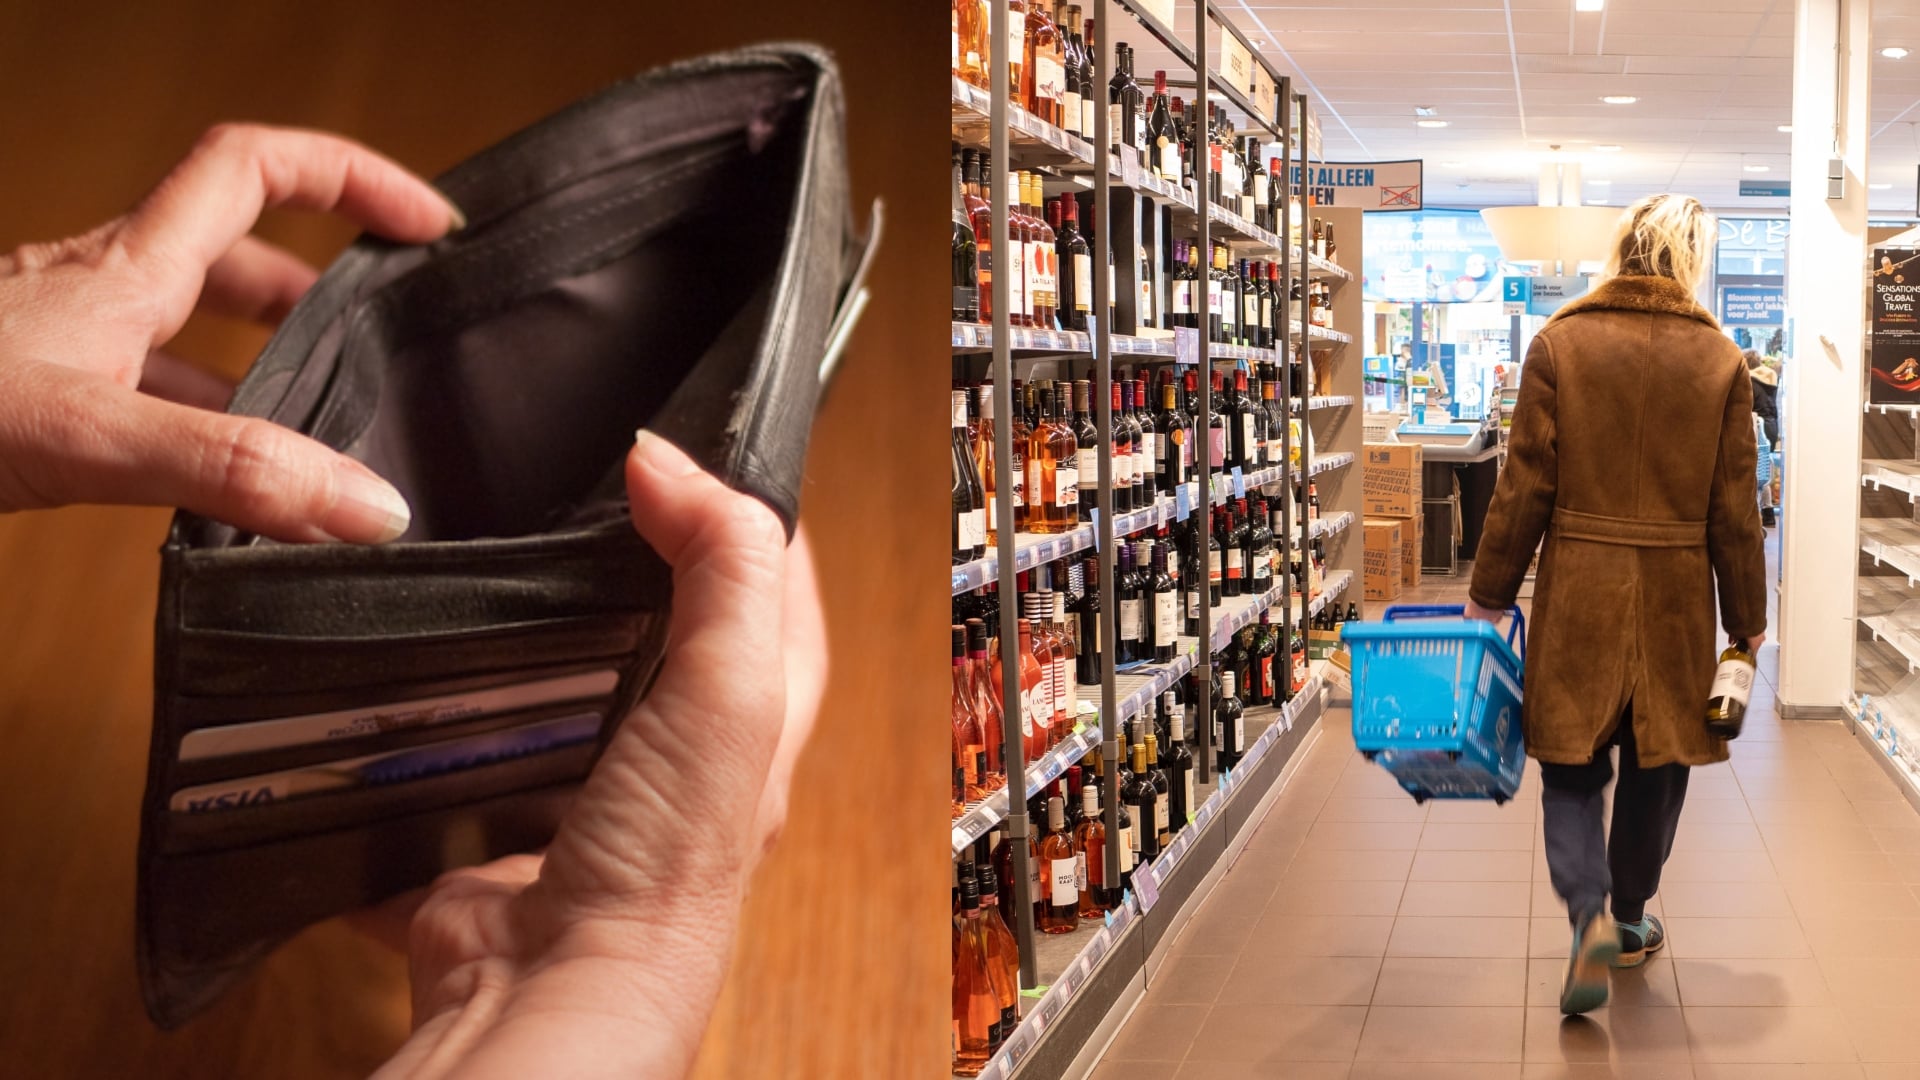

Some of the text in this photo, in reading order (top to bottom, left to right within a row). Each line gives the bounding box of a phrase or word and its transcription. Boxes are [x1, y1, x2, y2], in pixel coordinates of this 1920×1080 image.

[1318, 168, 1374, 187] ALLEEN
[1510, 282, 1519, 297] 5
[1876, 283, 1920, 293] SENSATIONS
[1882, 293, 1916, 302] GLOBAL
[1885, 302, 1914, 311] TRAVEL
[189, 786, 273, 814] VISA
